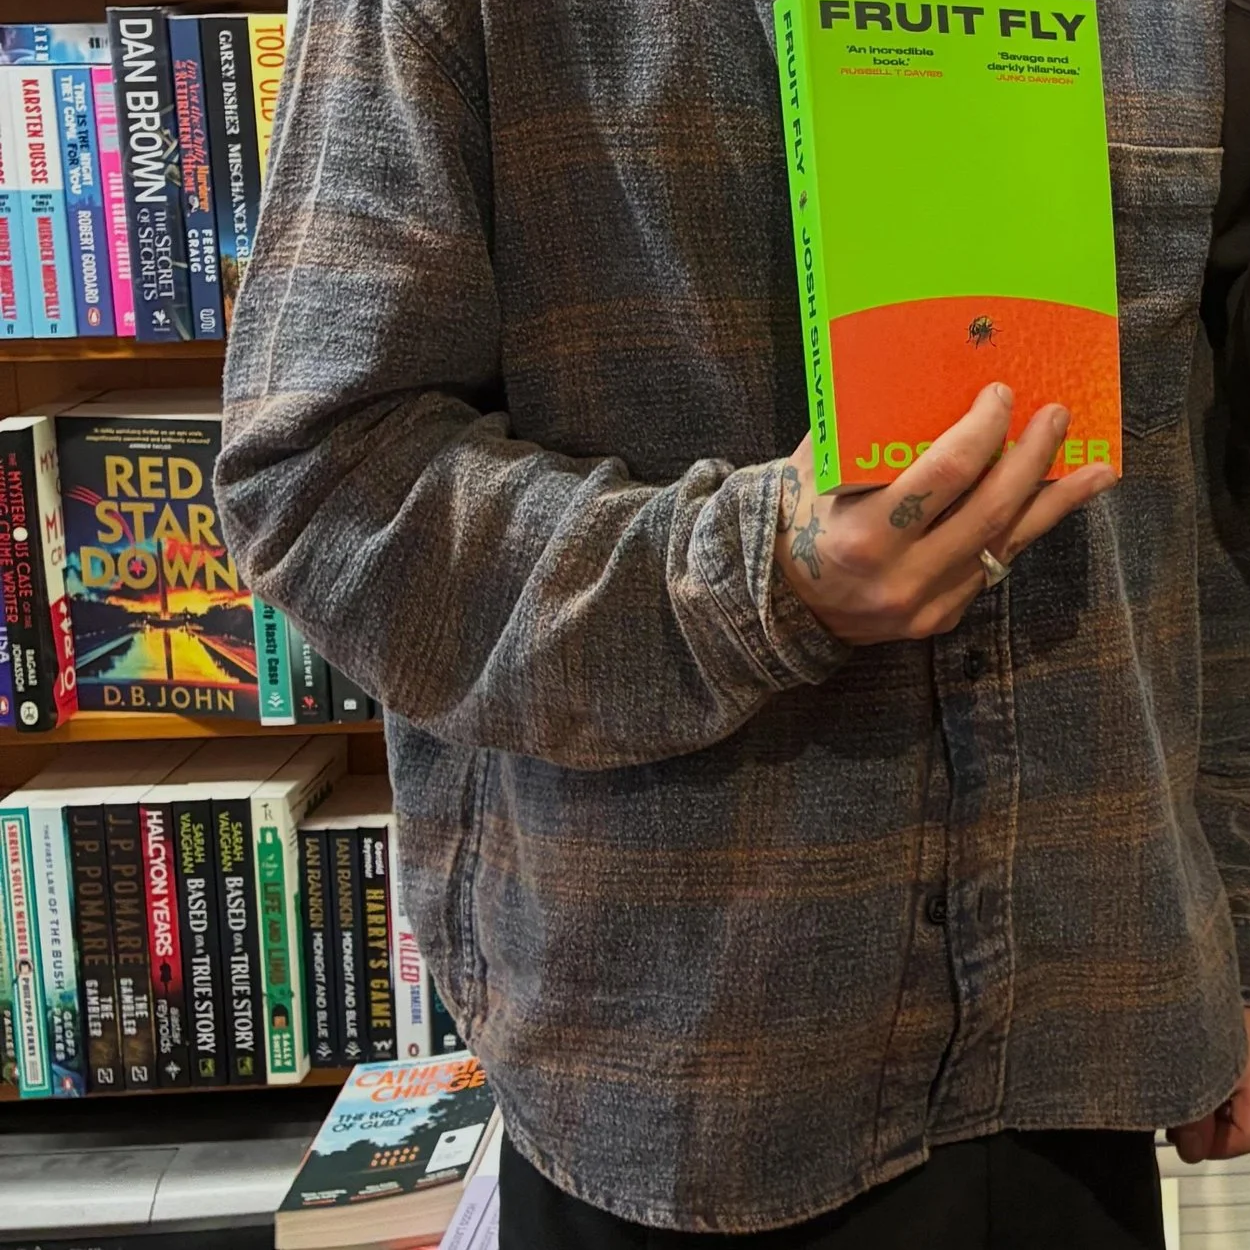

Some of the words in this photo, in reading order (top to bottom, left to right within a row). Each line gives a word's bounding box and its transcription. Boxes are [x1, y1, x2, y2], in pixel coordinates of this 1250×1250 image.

[819, 0, 984, 36] FRUIT
[999, 8, 1086, 42] FLY
[120, 18, 156, 83] DAN
[869, 46, 934, 56] incredible
[987, 62, 1024, 73] darkly
[1047, 55, 1069, 64] and
[21, 79, 43, 138] KARSTEN
[783, 10, 801, 109] FRUIT
[792, 116, 804, 175] FLY
[30, 142, 49, 184] DUSSE
[126, 89, 167, 203] BROWN
[156, 235, 175, 300] SECRET
[187, 229, 201, 273] CRAIG
[201, 229, 217, 282] FERGUS
[801, 226, 817, 319] JOSH
[809, 328, 828, 444] SILVER
[105, 456, 203, 499] RED
[855, 440, 944, 470] JOS
[94, 501, 221, 546] STAR
[80, 546, 239, 591] DOWN
[157, 689, 235, 712] JOHN
[144, 810, 167, 891] HALCYON
[150, 895, 172, 957] YEARS
[225, 877, 246, 932] BASED
